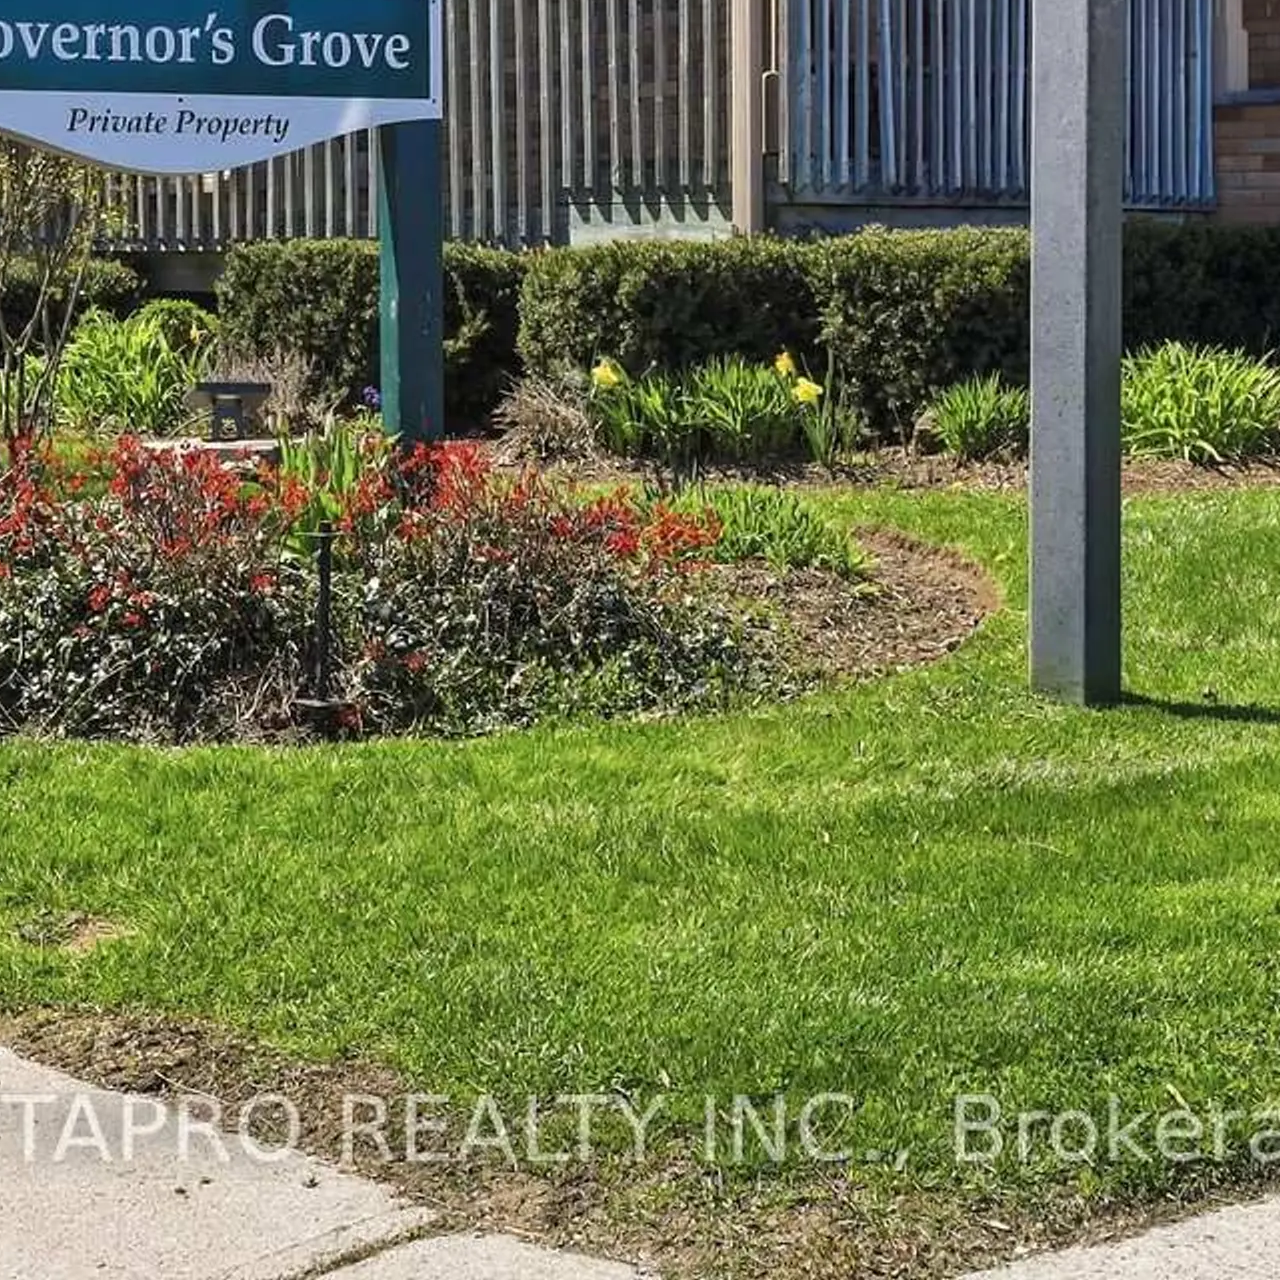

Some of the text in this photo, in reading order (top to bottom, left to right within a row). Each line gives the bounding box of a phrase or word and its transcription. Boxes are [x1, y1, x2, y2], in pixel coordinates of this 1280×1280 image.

[251, 14, 411, 69] Grove
[66, 107, 290, 143] Private Property
